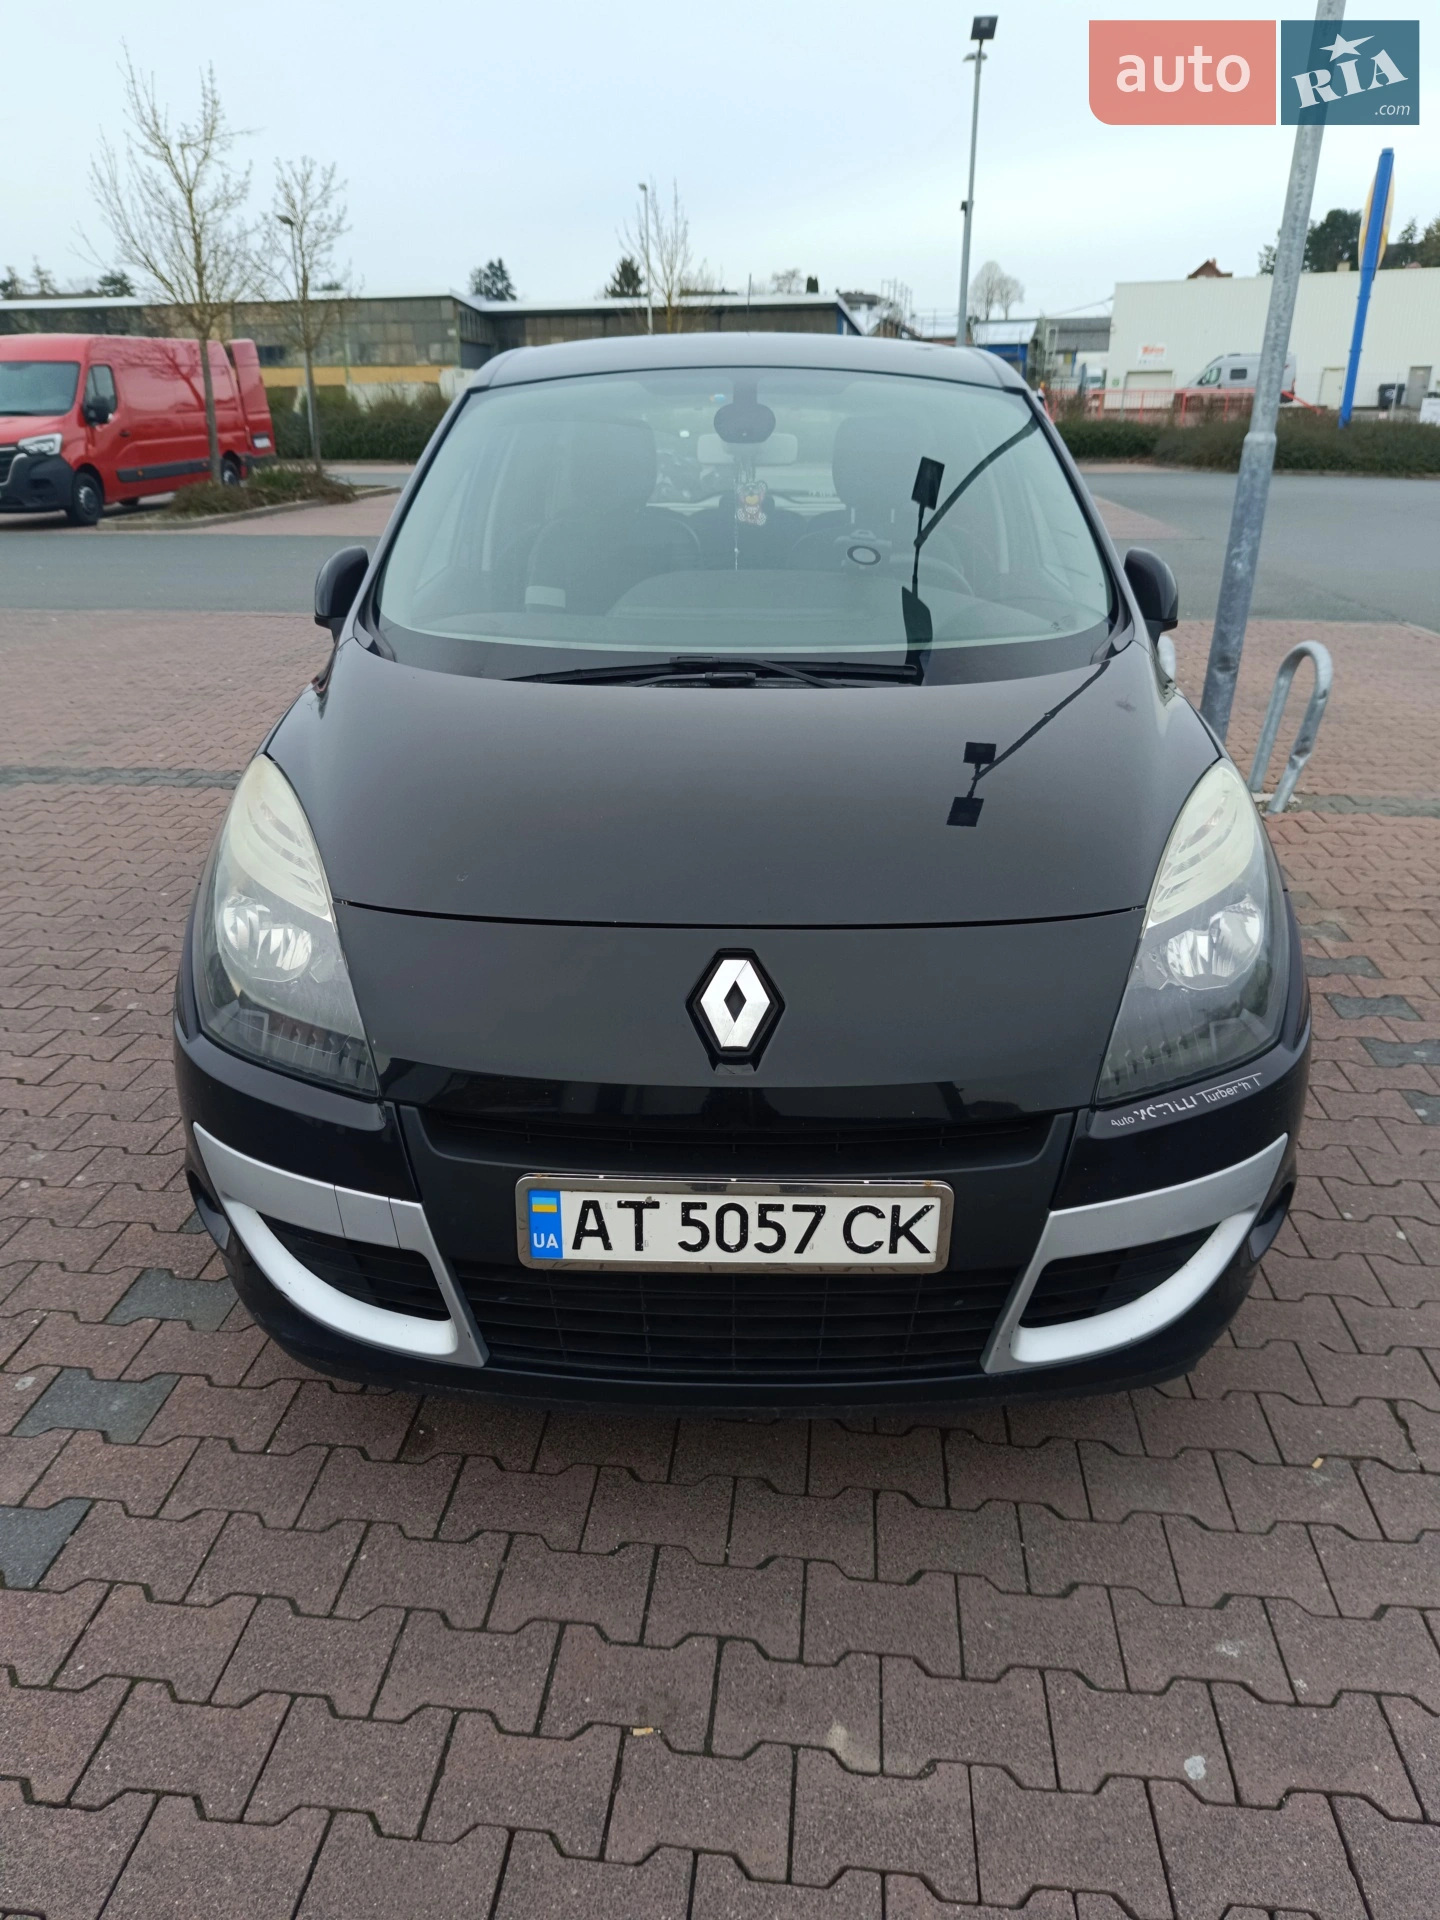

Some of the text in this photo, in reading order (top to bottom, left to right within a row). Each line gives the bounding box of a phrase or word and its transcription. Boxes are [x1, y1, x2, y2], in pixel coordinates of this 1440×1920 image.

[533, 1232, 559, 1249] UA
[571, 1200, 935, 1255] AT 5057 CK
